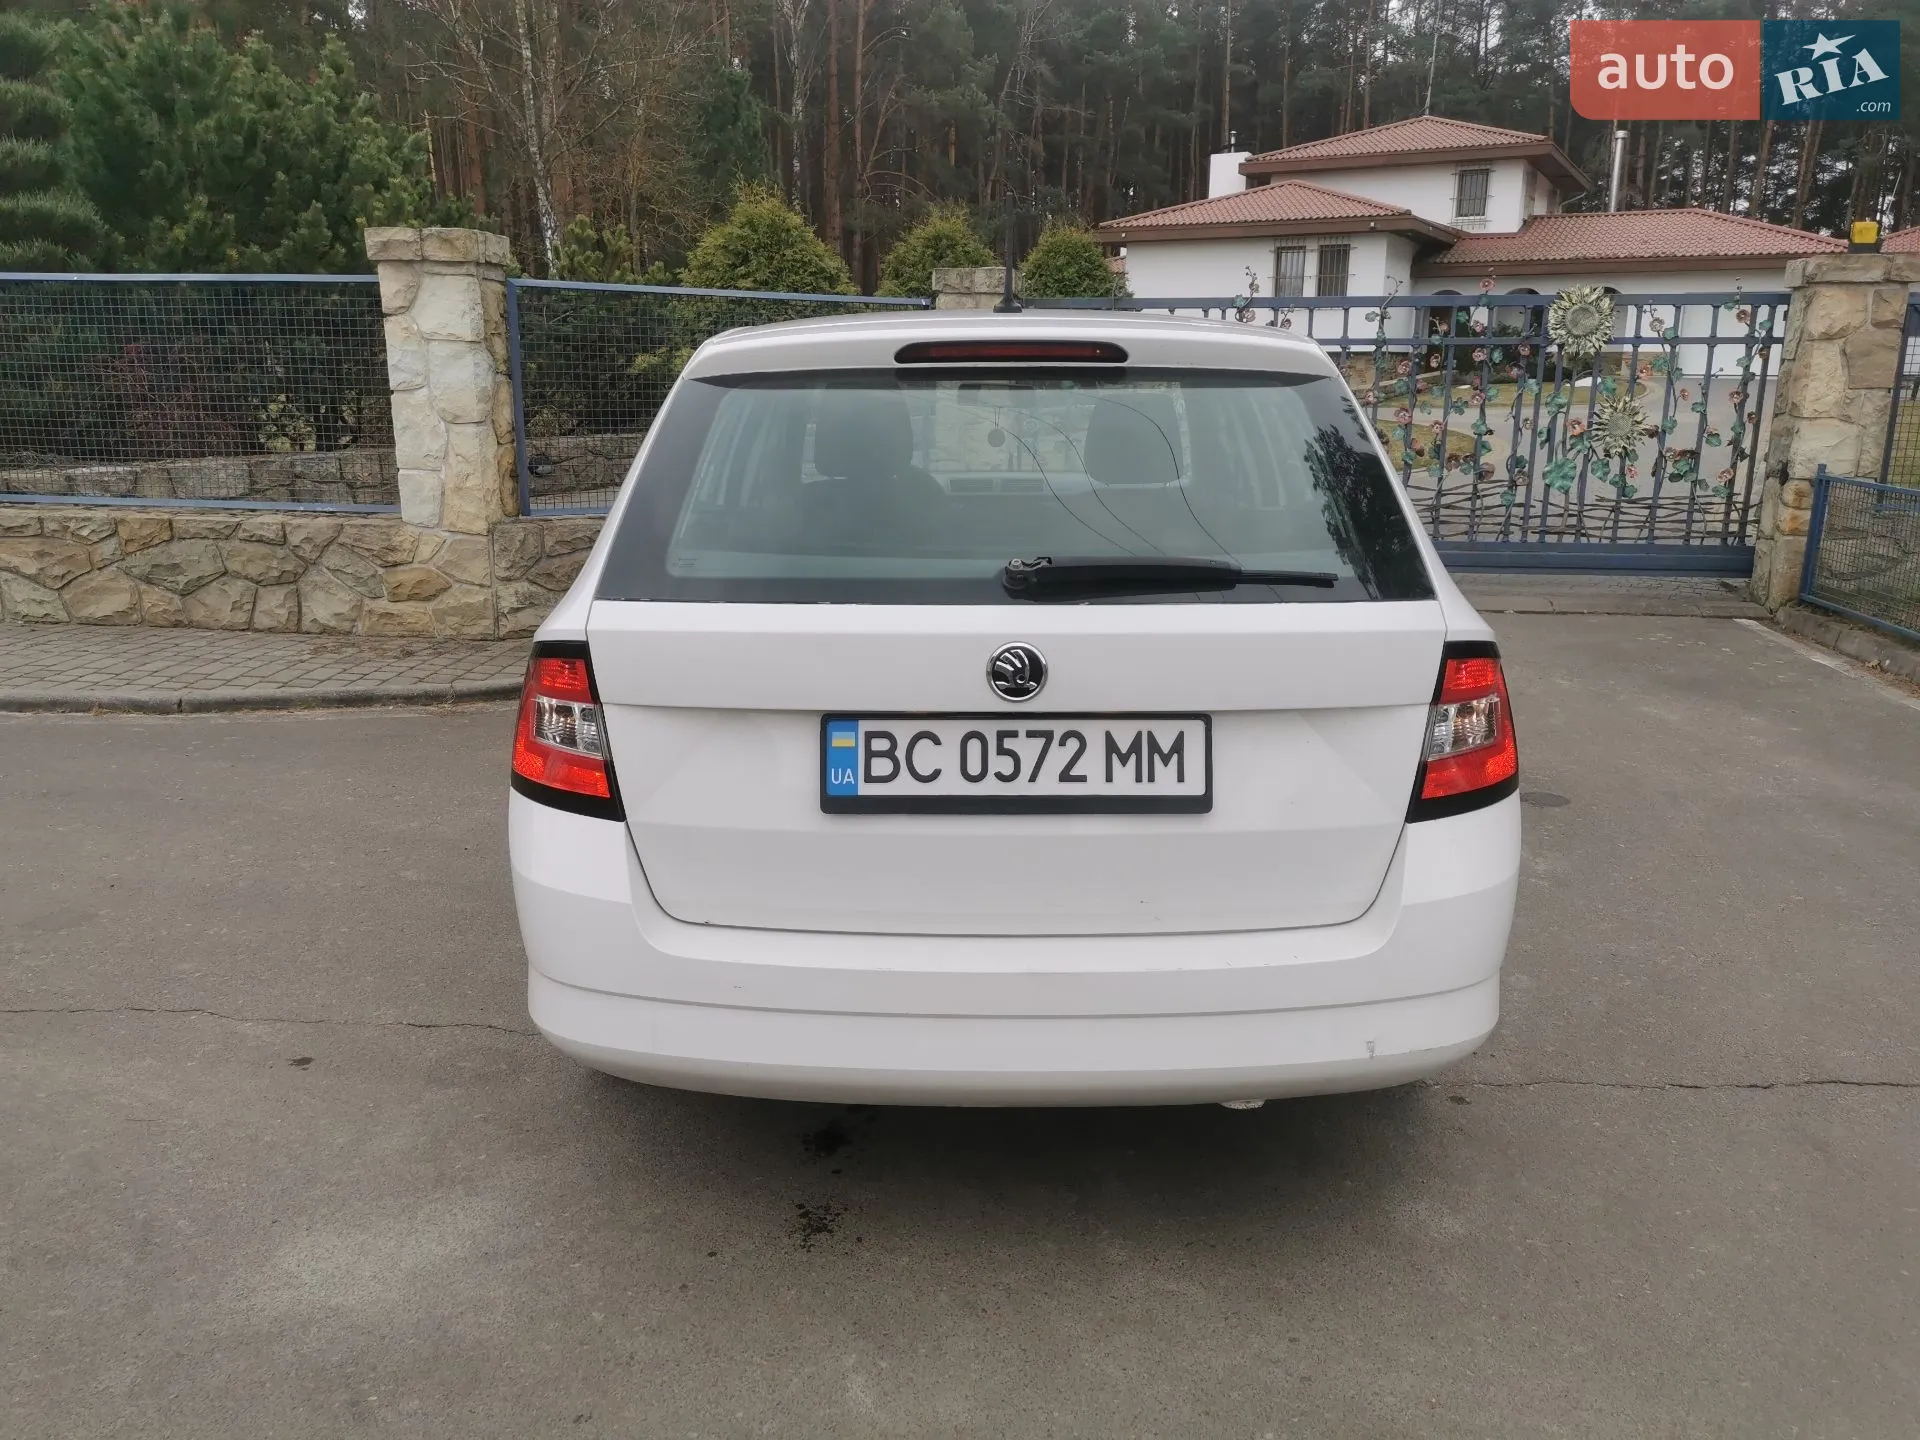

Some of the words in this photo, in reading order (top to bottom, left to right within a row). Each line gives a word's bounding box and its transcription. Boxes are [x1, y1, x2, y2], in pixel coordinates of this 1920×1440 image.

[863, 730, 942, 784] BC
[959, 729, 1088, 783] 0572
[1105, 730, 1185, 783] MM
[831, 768, 855, 785] UA
